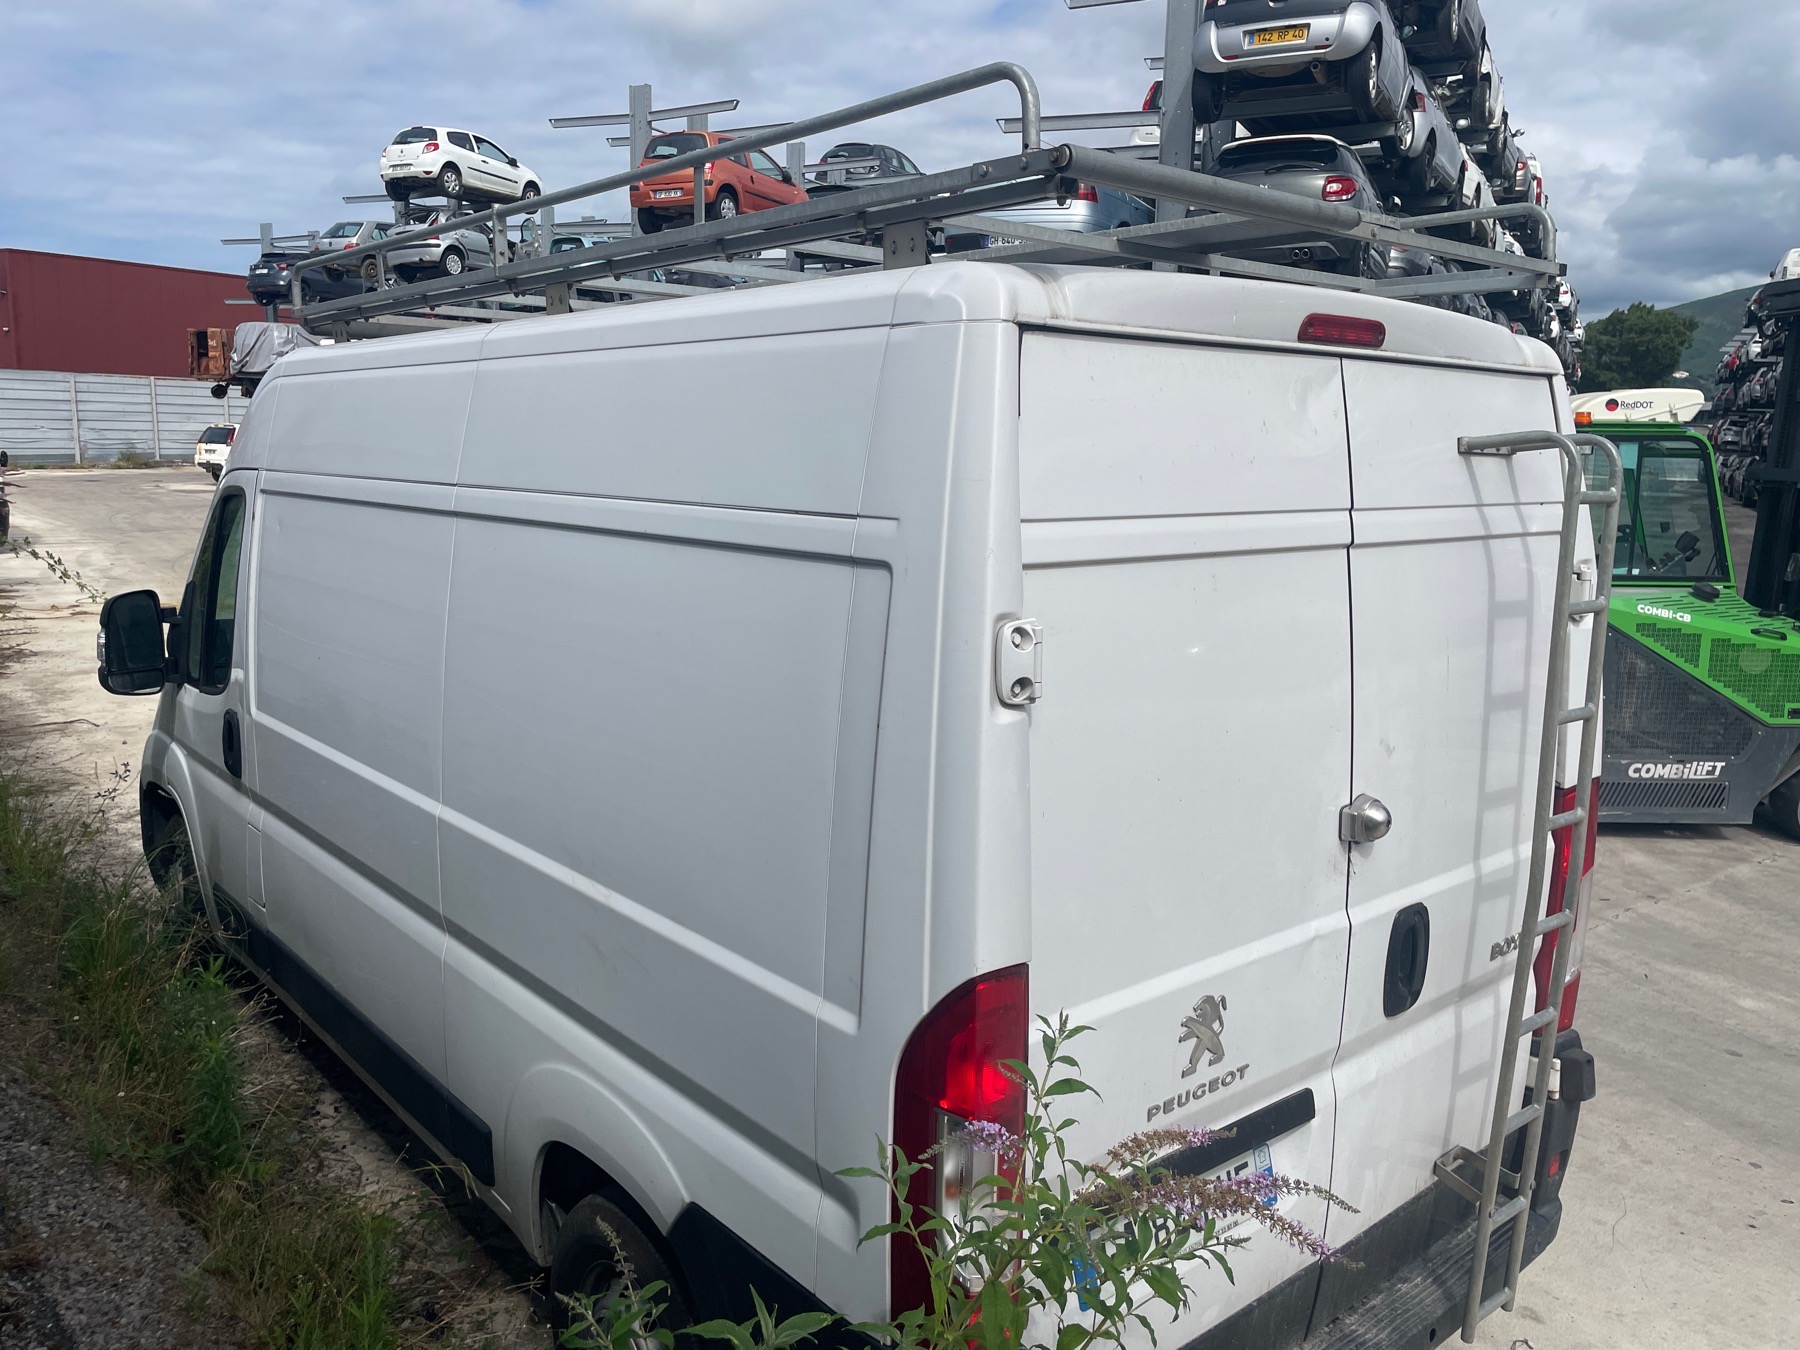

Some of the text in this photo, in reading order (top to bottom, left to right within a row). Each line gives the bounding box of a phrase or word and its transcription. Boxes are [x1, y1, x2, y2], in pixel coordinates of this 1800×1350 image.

[1257, 28, 1304, 43] 142 RP 40
[1620, 400, 1654, 409] RedDOT
[1637, 604, 1692, 623] COMBi-CB
[1628, 762, 1726, 779] COMBiLiFT
[1490, 933, 1520, 962] BOX
[1147, 1063, 1250, 1123] PEUGEOT
